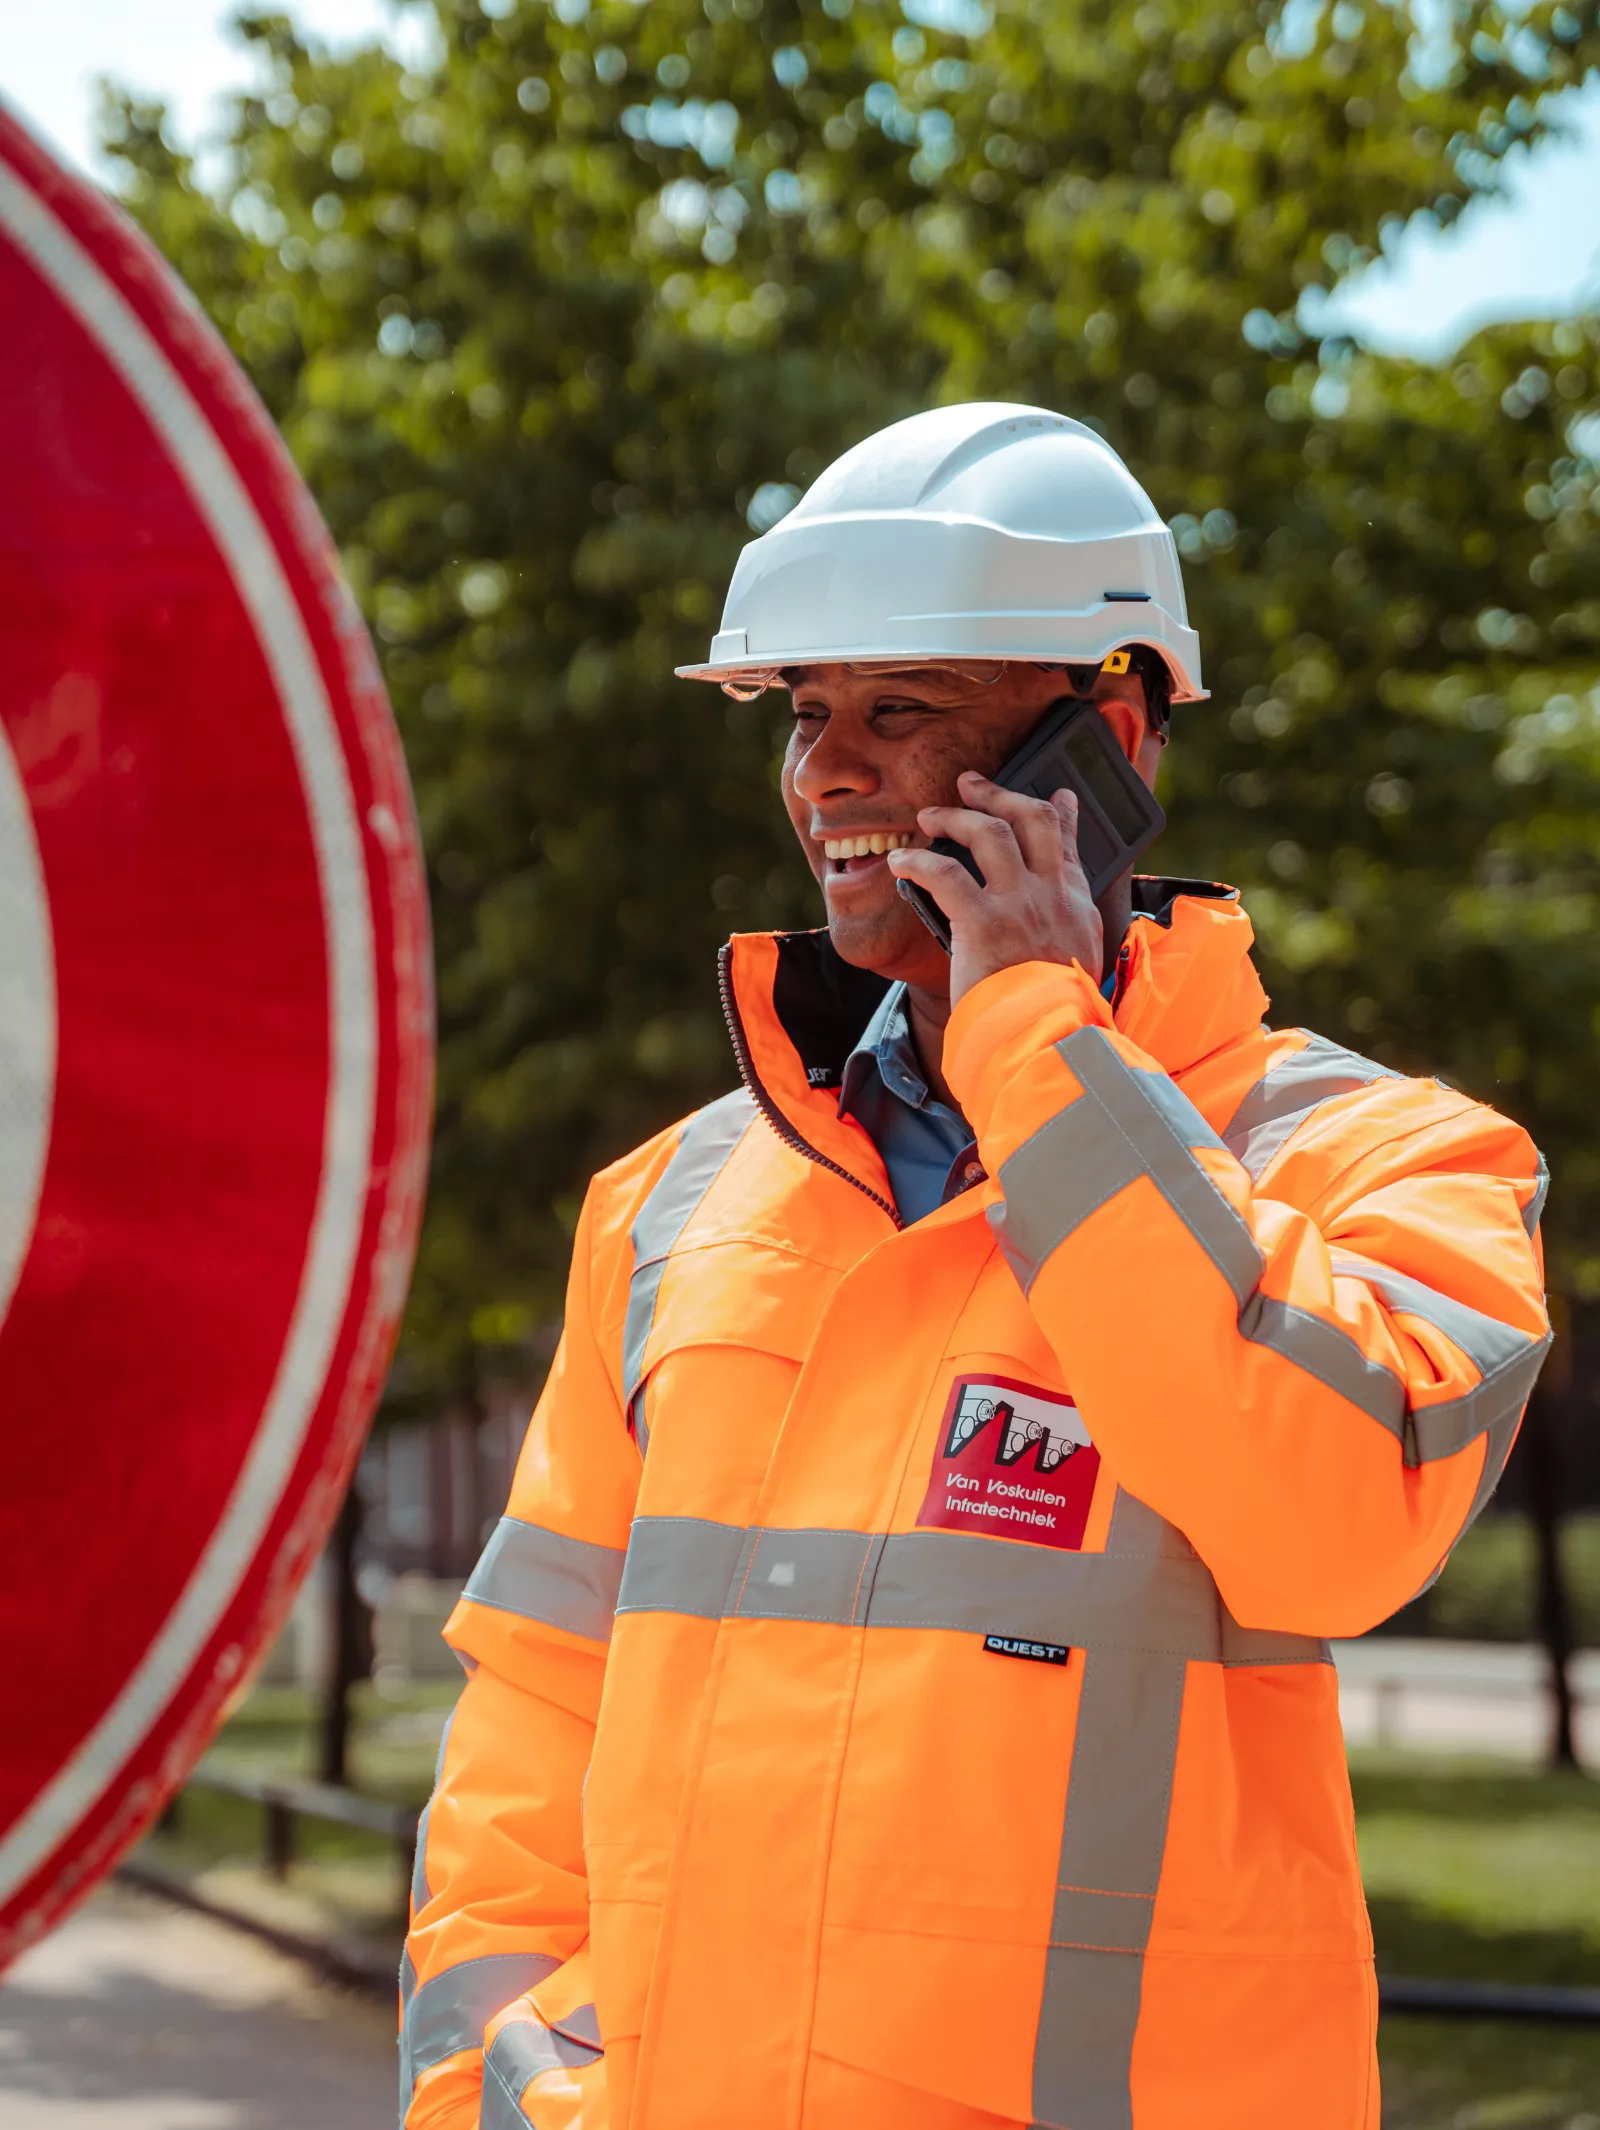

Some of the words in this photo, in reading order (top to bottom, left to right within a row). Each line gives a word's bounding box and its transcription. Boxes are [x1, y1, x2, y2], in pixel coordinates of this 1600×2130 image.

[946, 1472, 979, 1491] Van
[987, 1479, 1066, 1508] Voskuilen
[945, 1495, 1056, 1529] Infratechniek
